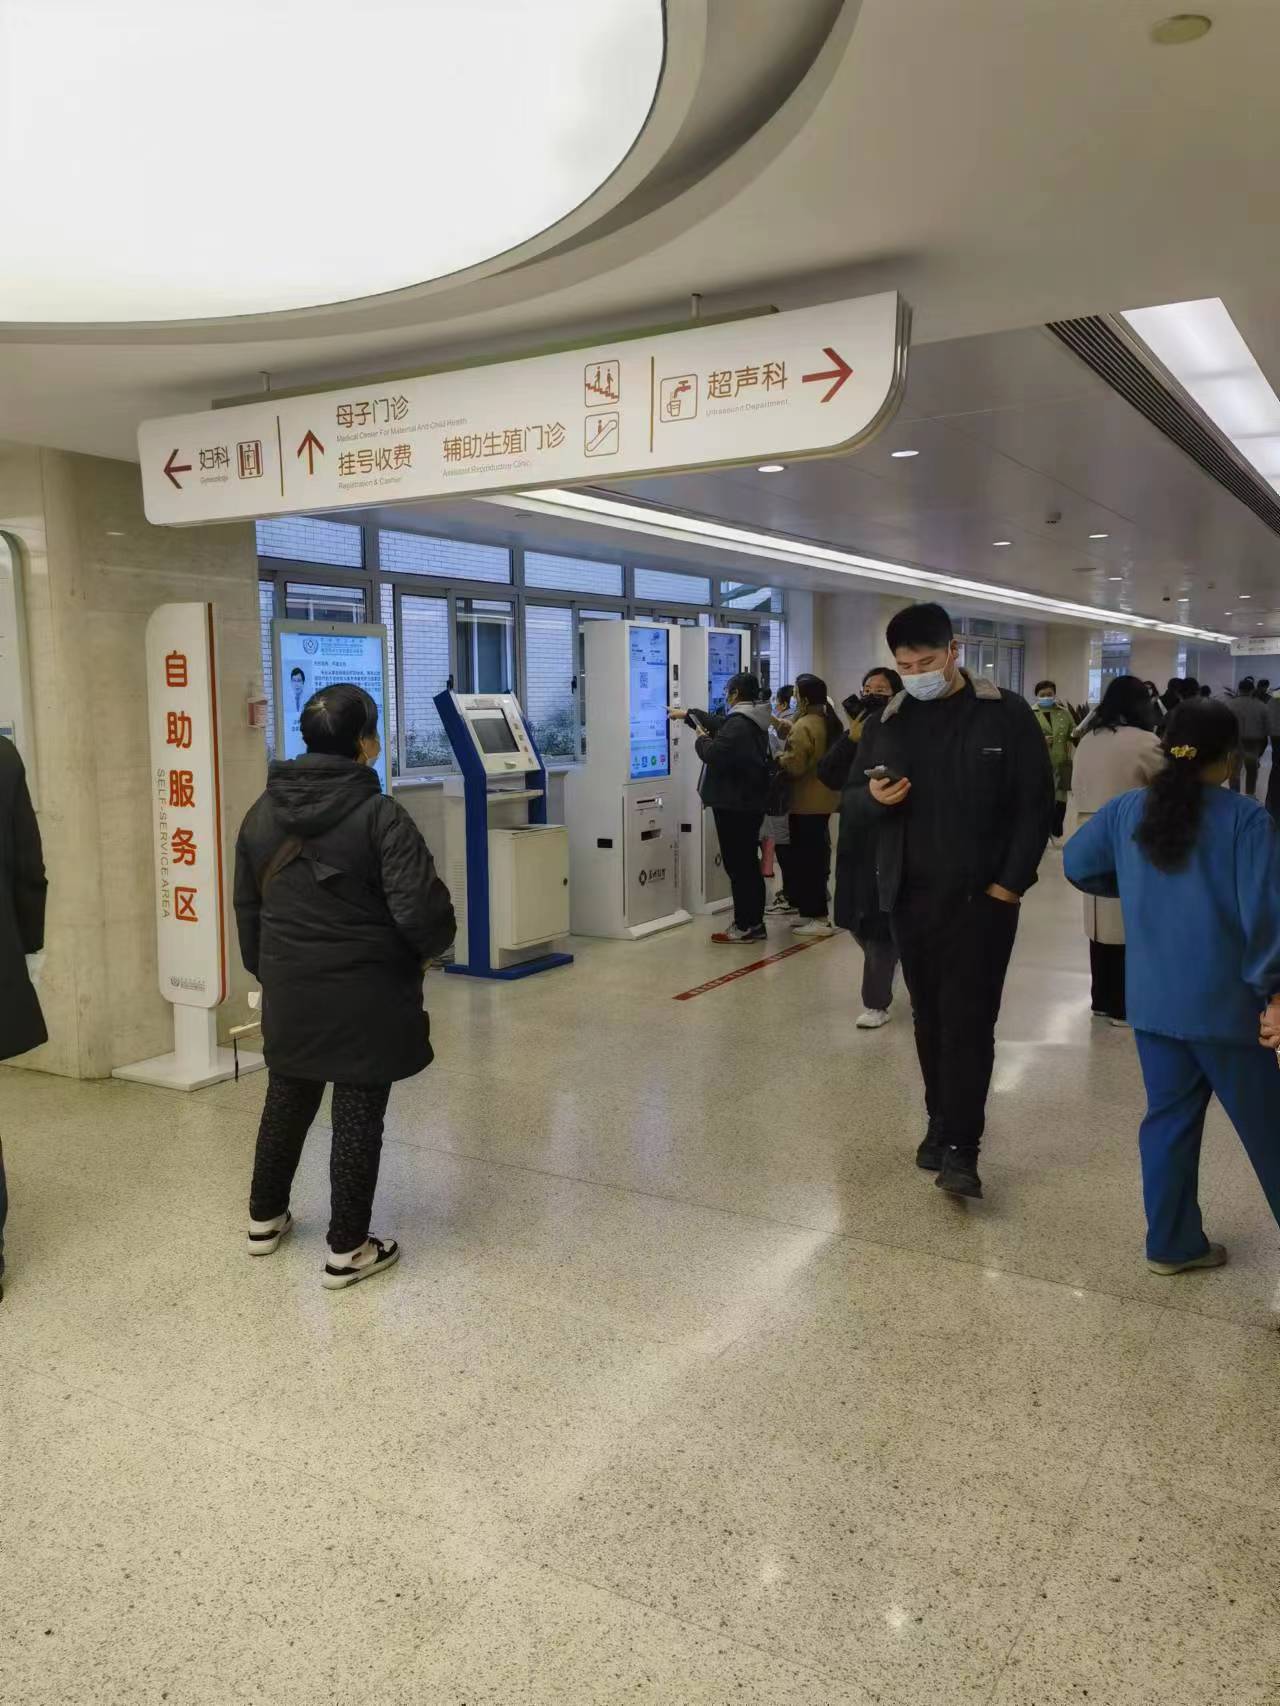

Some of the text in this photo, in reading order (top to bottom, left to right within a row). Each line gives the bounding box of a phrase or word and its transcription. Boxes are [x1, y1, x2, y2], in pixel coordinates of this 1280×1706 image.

[707, 361, 788, 400] 超声科
[336, 396, 409, 428] 母子门诊
[745, 399, 788, 411] Department
[199, 446, 230, 471] 妇科
[338, 443, 412, 476] 挂号收费
[442, 421, 566, 462] 辅助生殖门诊
[165, 649, 199, 923] 自助服务区
[156, 768, 170, 919] SELF-SERVICE AREA
